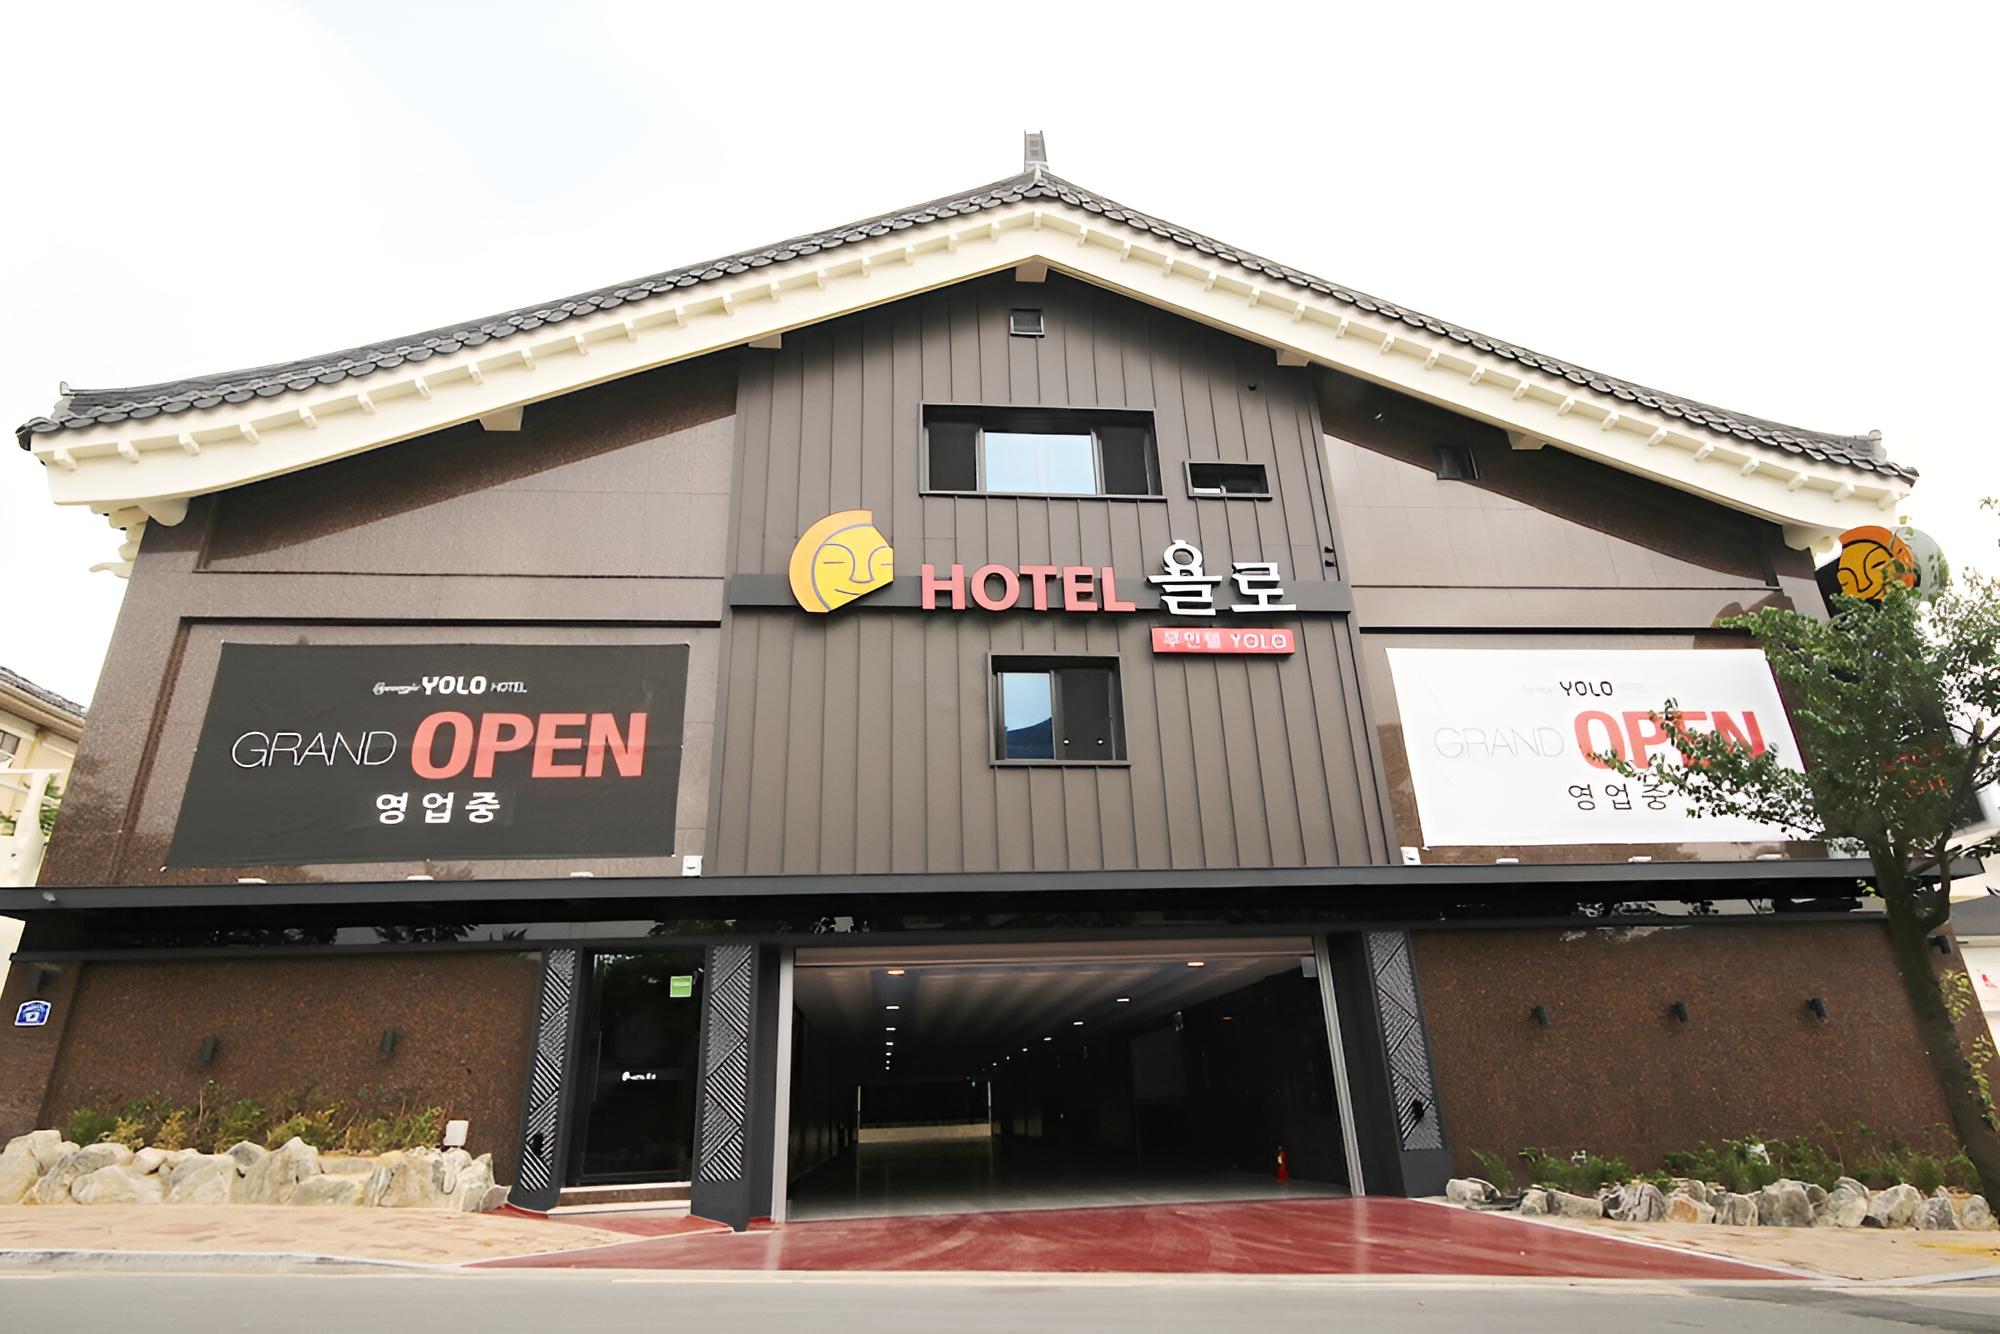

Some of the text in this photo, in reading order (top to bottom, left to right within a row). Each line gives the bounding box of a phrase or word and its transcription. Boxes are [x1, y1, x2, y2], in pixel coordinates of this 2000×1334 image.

[921, 539, 1297, 616] HOTEL 욜로
[1229, 632, 1288, 650] YOLO
[421, 675, 487, 695] YOLO
[1559, 680, 1613, 697] YOLO
[231, 711, 648, 780] GRAND OPEN
[1433, 710, 1768, 770] GRAND OPEN
